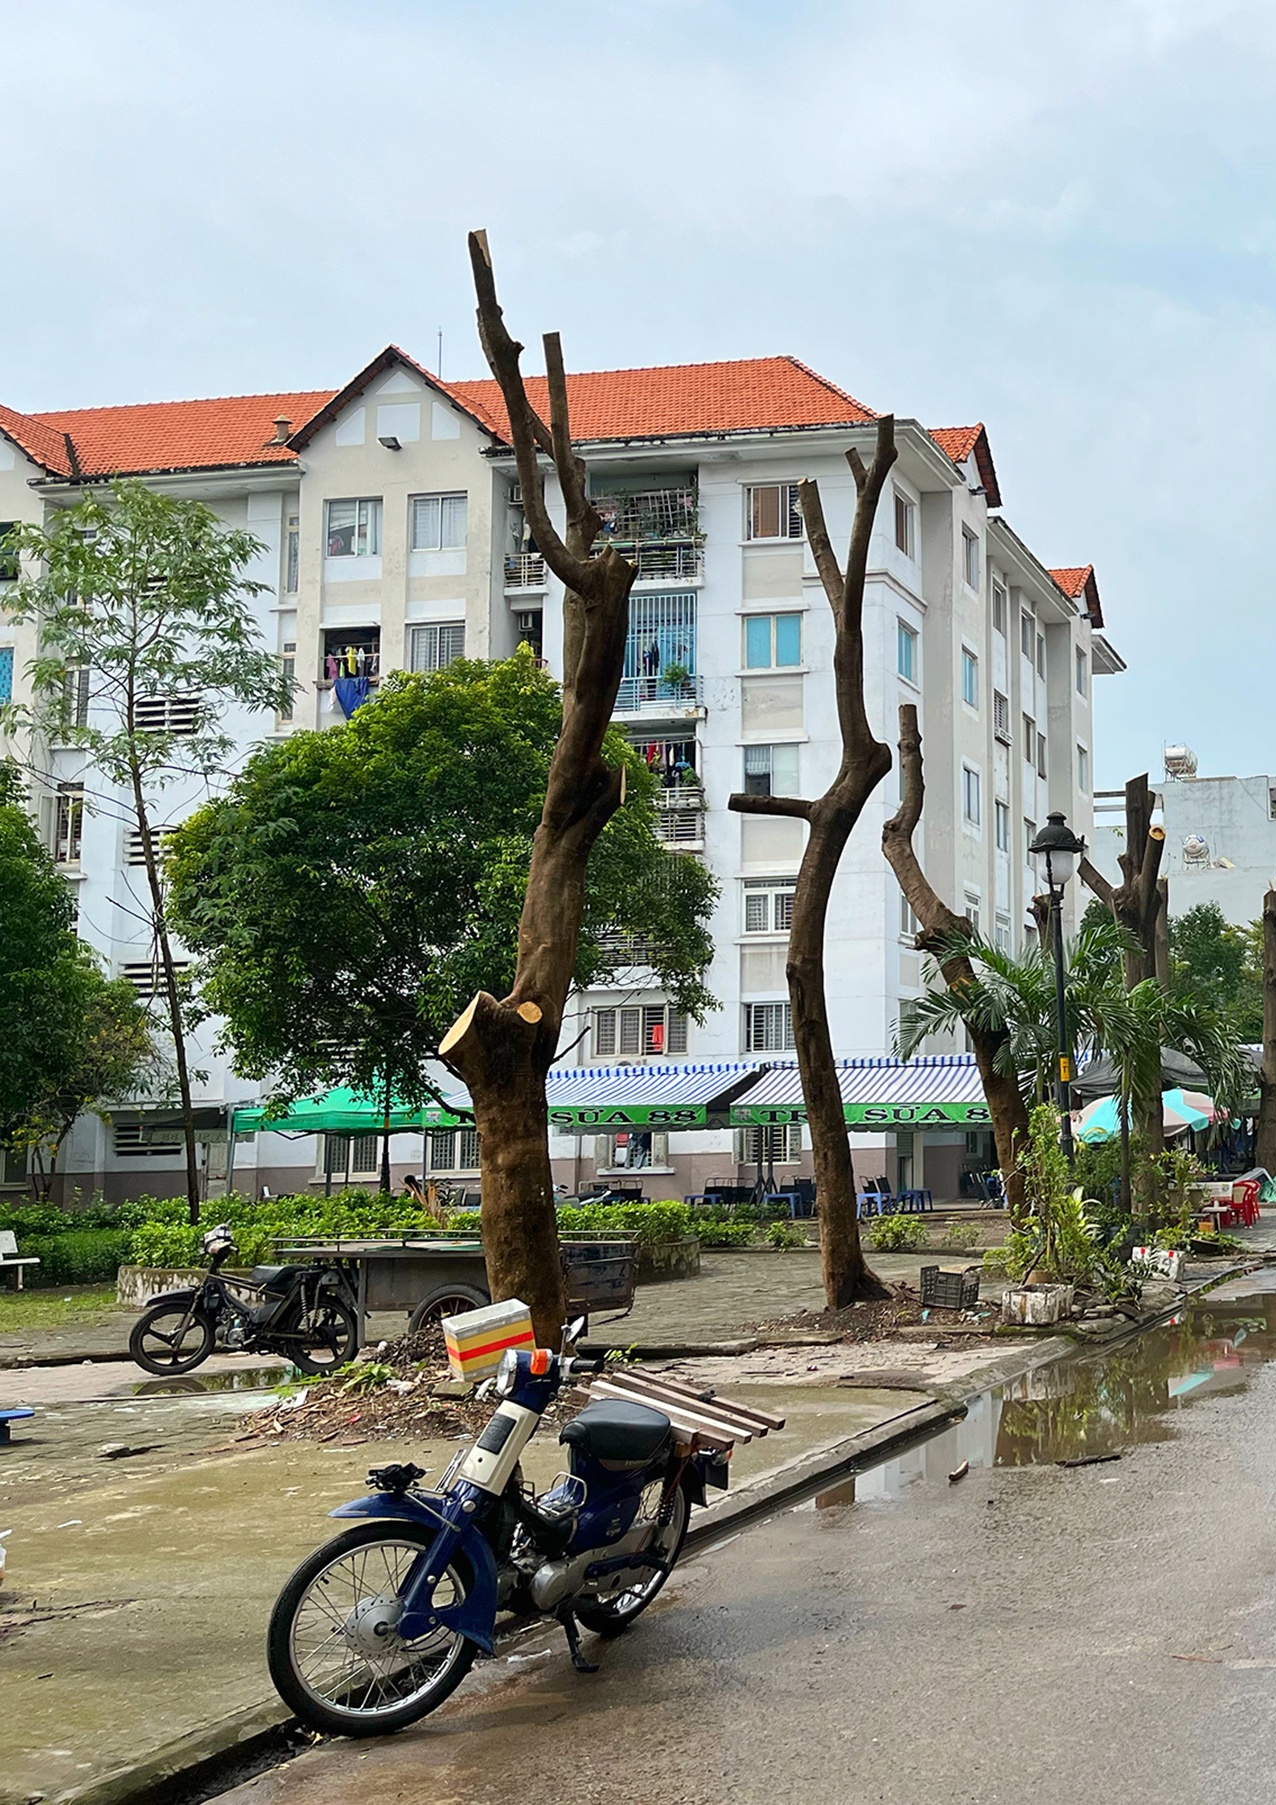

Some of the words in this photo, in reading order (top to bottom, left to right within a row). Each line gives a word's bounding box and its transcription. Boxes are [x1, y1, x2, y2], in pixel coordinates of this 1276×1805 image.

[551, 1108, 633, 1124] SỮA
[648, 1109, 697, 1122] 88
[864, 1105, 948, 1121] SỮA
